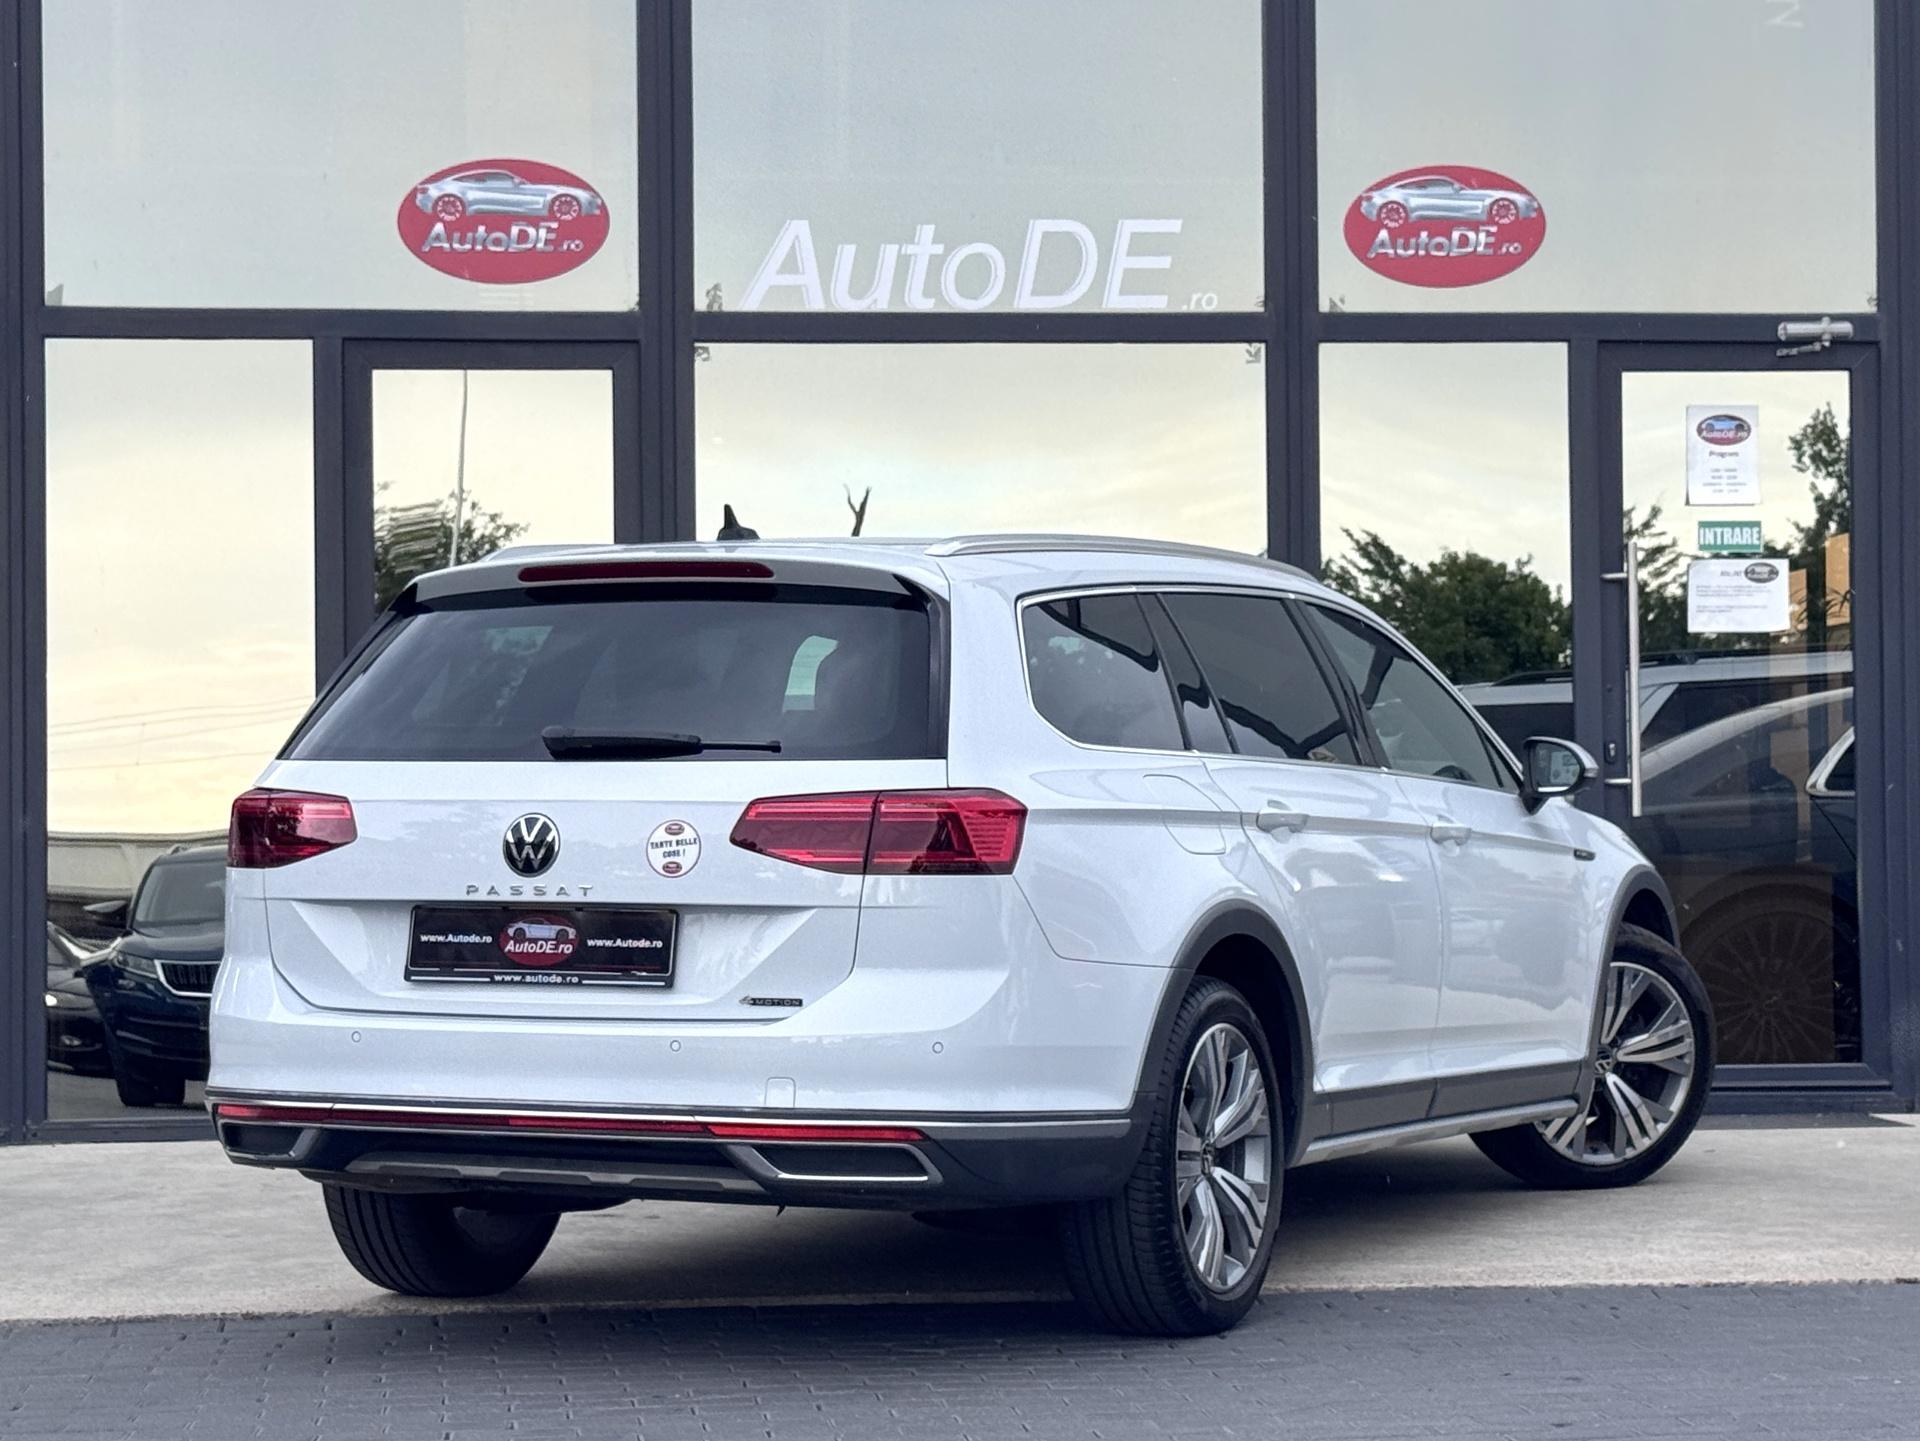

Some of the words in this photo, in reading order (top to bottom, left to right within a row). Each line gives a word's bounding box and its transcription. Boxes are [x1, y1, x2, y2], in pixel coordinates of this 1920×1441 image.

[1699, 526, 1760, 546] INTRARE
[675, 837, 698, 847] BELLE
[465, 884, 594, 897] PASSAT
[420, 933, 493, 944] www.Autode.ro
[586, 937, 663, 949] www.Autode.ro
[504, 939, 574, 955] AutoDE.ro
[493, 973, 579, 985] www.autode.ro
